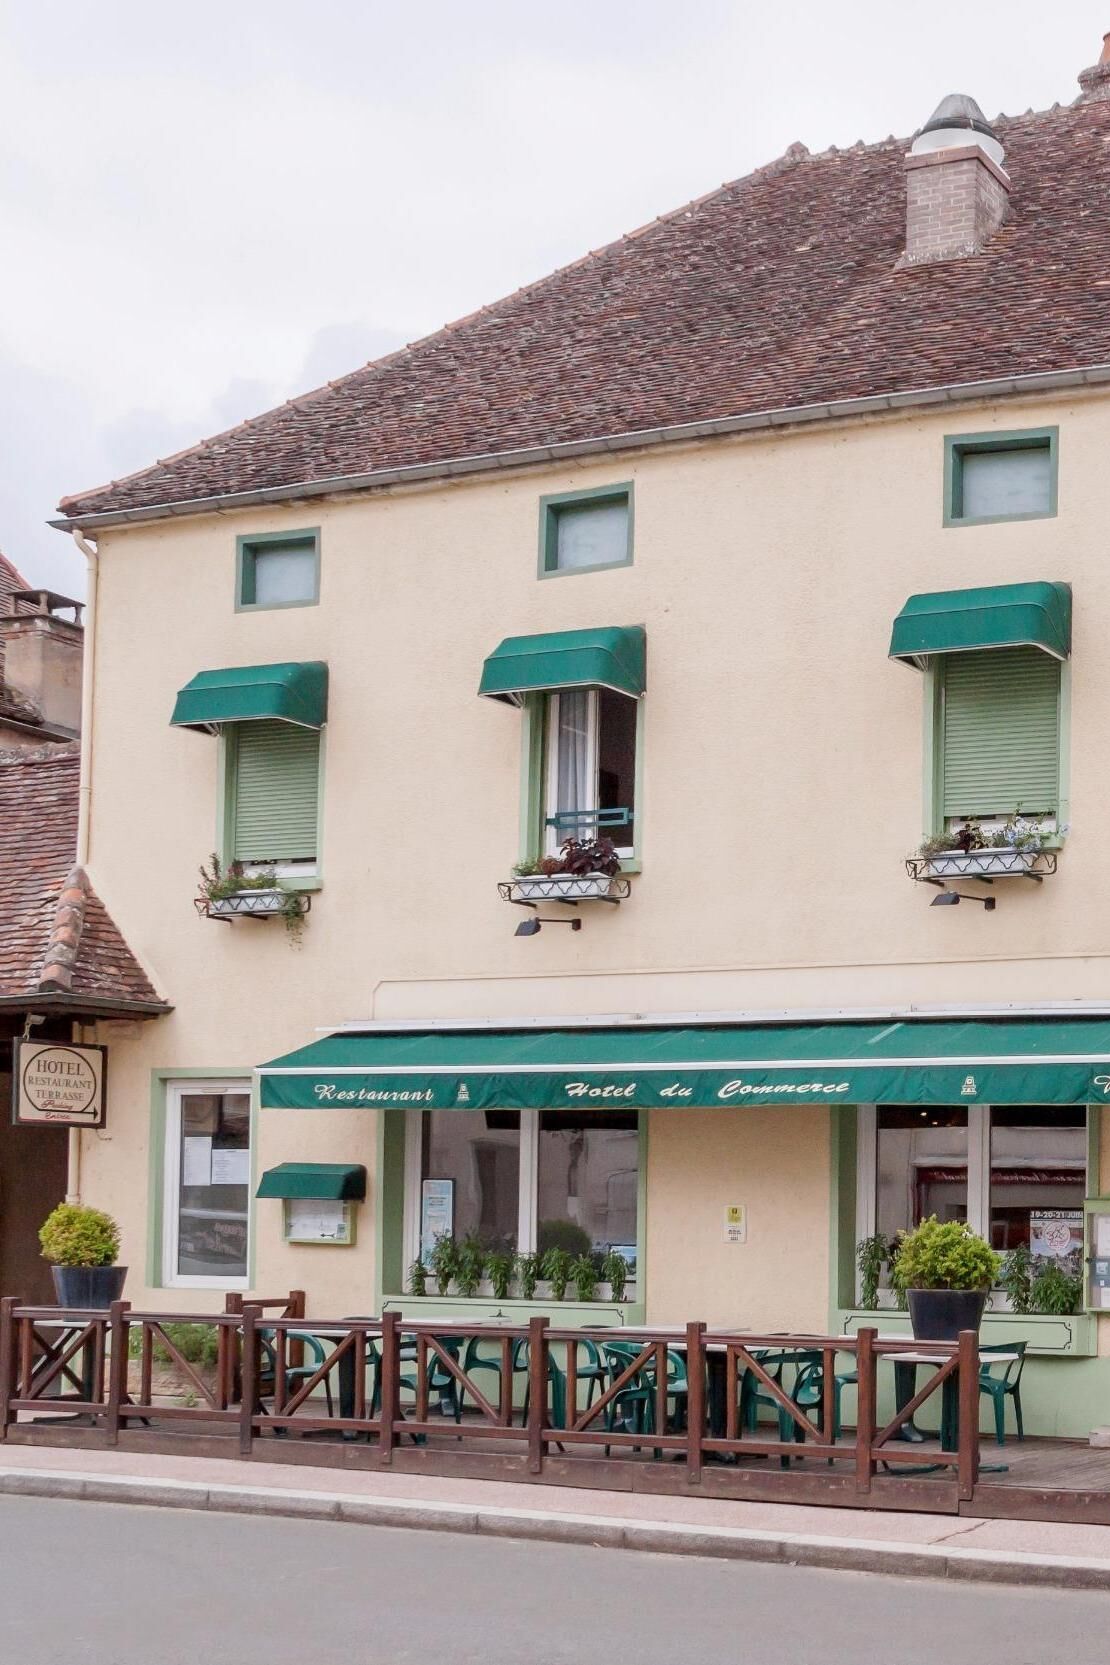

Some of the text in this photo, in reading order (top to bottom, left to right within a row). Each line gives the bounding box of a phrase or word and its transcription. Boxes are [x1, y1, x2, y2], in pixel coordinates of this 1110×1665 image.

[37, 1060, 85, 1076] HOTEL
[28, 1075, 92, 1089] RESTAURANT
[565, 1080, 850, 1099] Hotel du Commerce
[35, 1090, 85, 1102] TERRASSE
[314, 1084, 434, 1101] Restaurant
